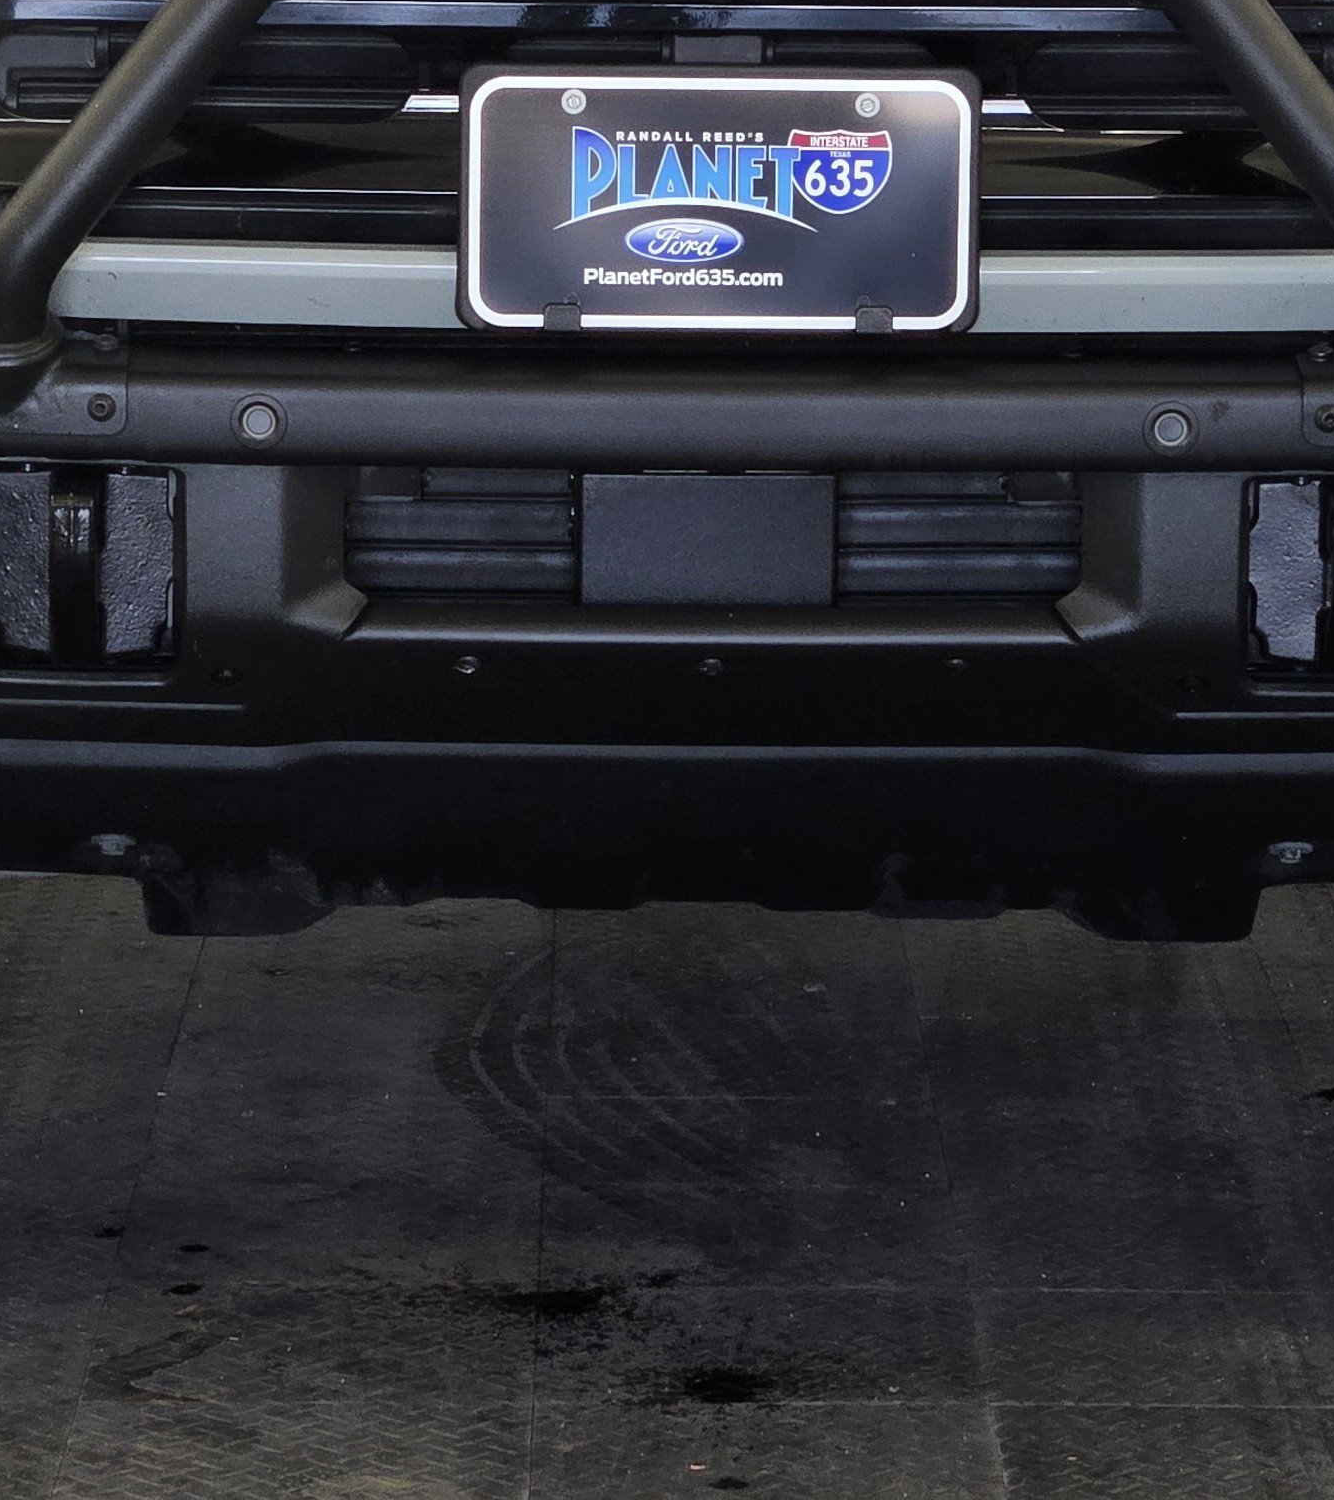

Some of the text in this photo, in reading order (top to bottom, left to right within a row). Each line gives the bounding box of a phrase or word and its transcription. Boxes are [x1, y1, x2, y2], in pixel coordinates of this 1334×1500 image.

[616, 131, 764, 143] RANDALL REED'S
[810, 136, 869, 148] INTERSTATE
[829, 150, 851, 158] TEXAS
[572, 126, 801, 220] PLANET
[804, 159, 875, 197] 635
[647, 225, 719, 257] Ford
[583, 267, 784, 287] PlanetFord635.com
